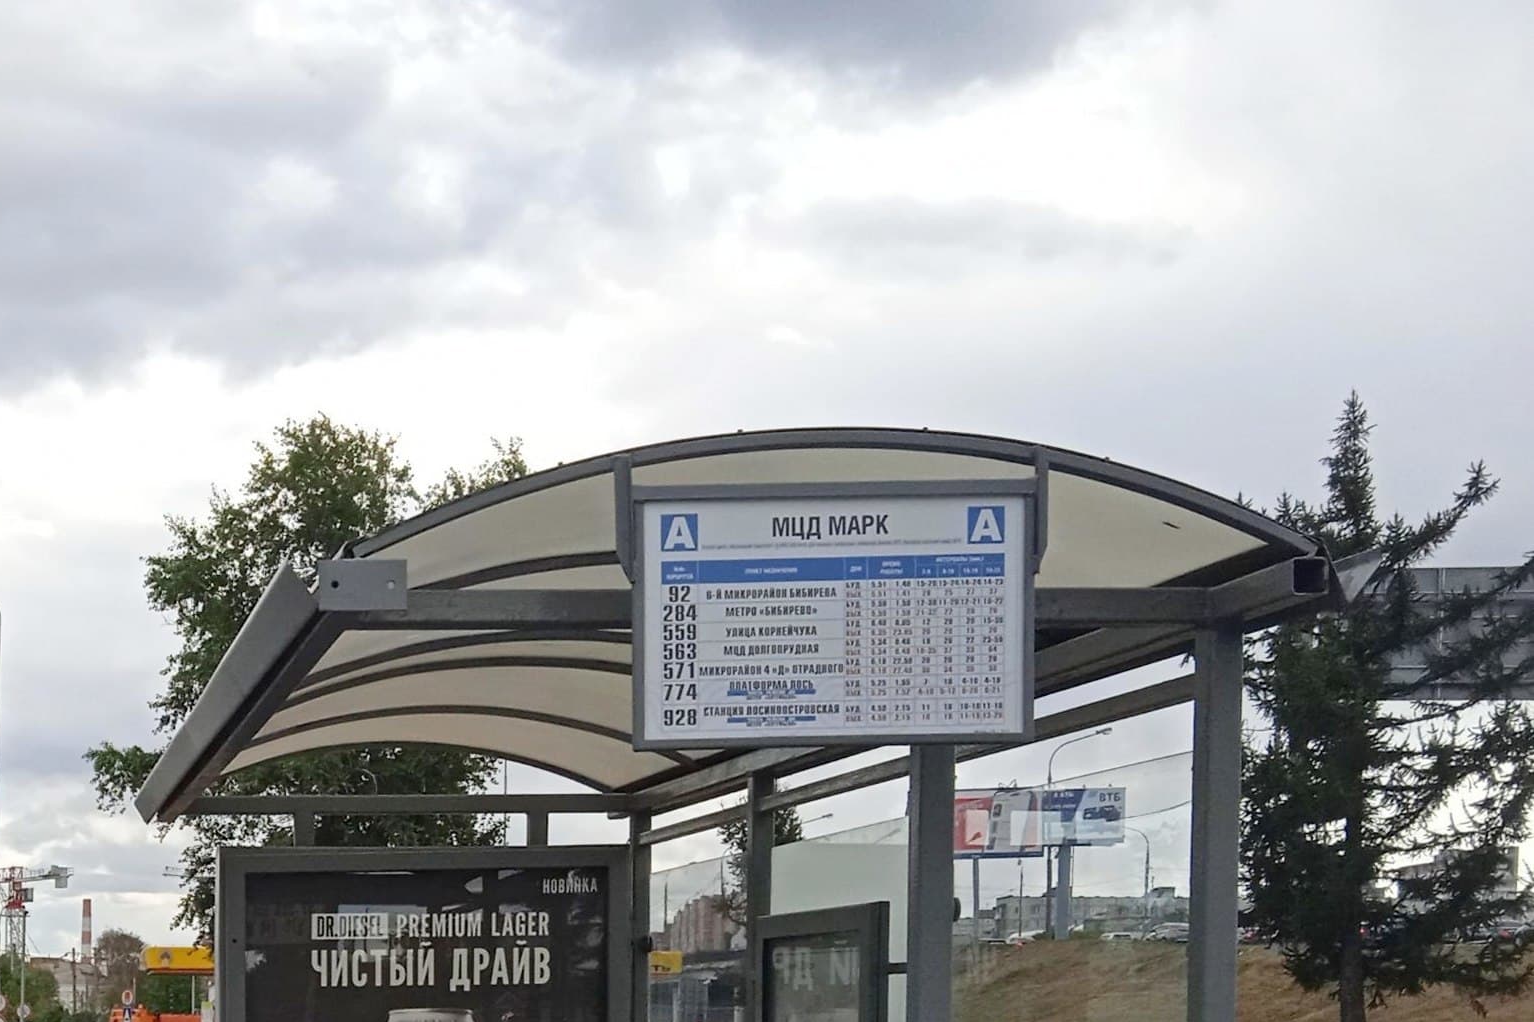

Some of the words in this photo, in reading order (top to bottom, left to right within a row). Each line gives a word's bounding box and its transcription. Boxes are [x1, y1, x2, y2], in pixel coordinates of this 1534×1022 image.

[663, 516, 696, 550] А
[772, 516, 821, 540] МЦД
[829, 513, 889, 537] МАРК
[969, 508, 1003, 542] А
[669, 586, 691, 602] 92
[724, 588, 787, 600] МИКРОРАЙОН
[790, 587, 837, 598] БИБИРЕВА
[663, 605, 697, 621] 284
[725, 607, 756, 617] МЕТРО
[663, 624, 697, 641] 559
[725, 627, 756, 638] УЛИЦА
[663, 643, 697, 660] 563
[749, 644, 819, 655] ДОЛГОПРУДНАЯ
[663, 662, 695, 679] 571
[699, 665, 761, 676] МИКРОРАЙОН
[764, 666, 770, 675] 4
[792, 664, 844, 675] ОТРАДНОГО
[663, 683, 697, 700] 774
[663, 709, 697, 726] 928
[703, 706, 744, 716] СТАНЦИЯ
[543, 878, 598, 894] НОВИНКА
[316, 915, 384, 937] DR.DIESEL
[396, 913, 482, 938] PREMIUM
[491, 911, 550, 937] LAGER
[311, 941, 435, 988] ЧИСТЫЙ
[449, 940, 551, 992] ДРАЙВ
